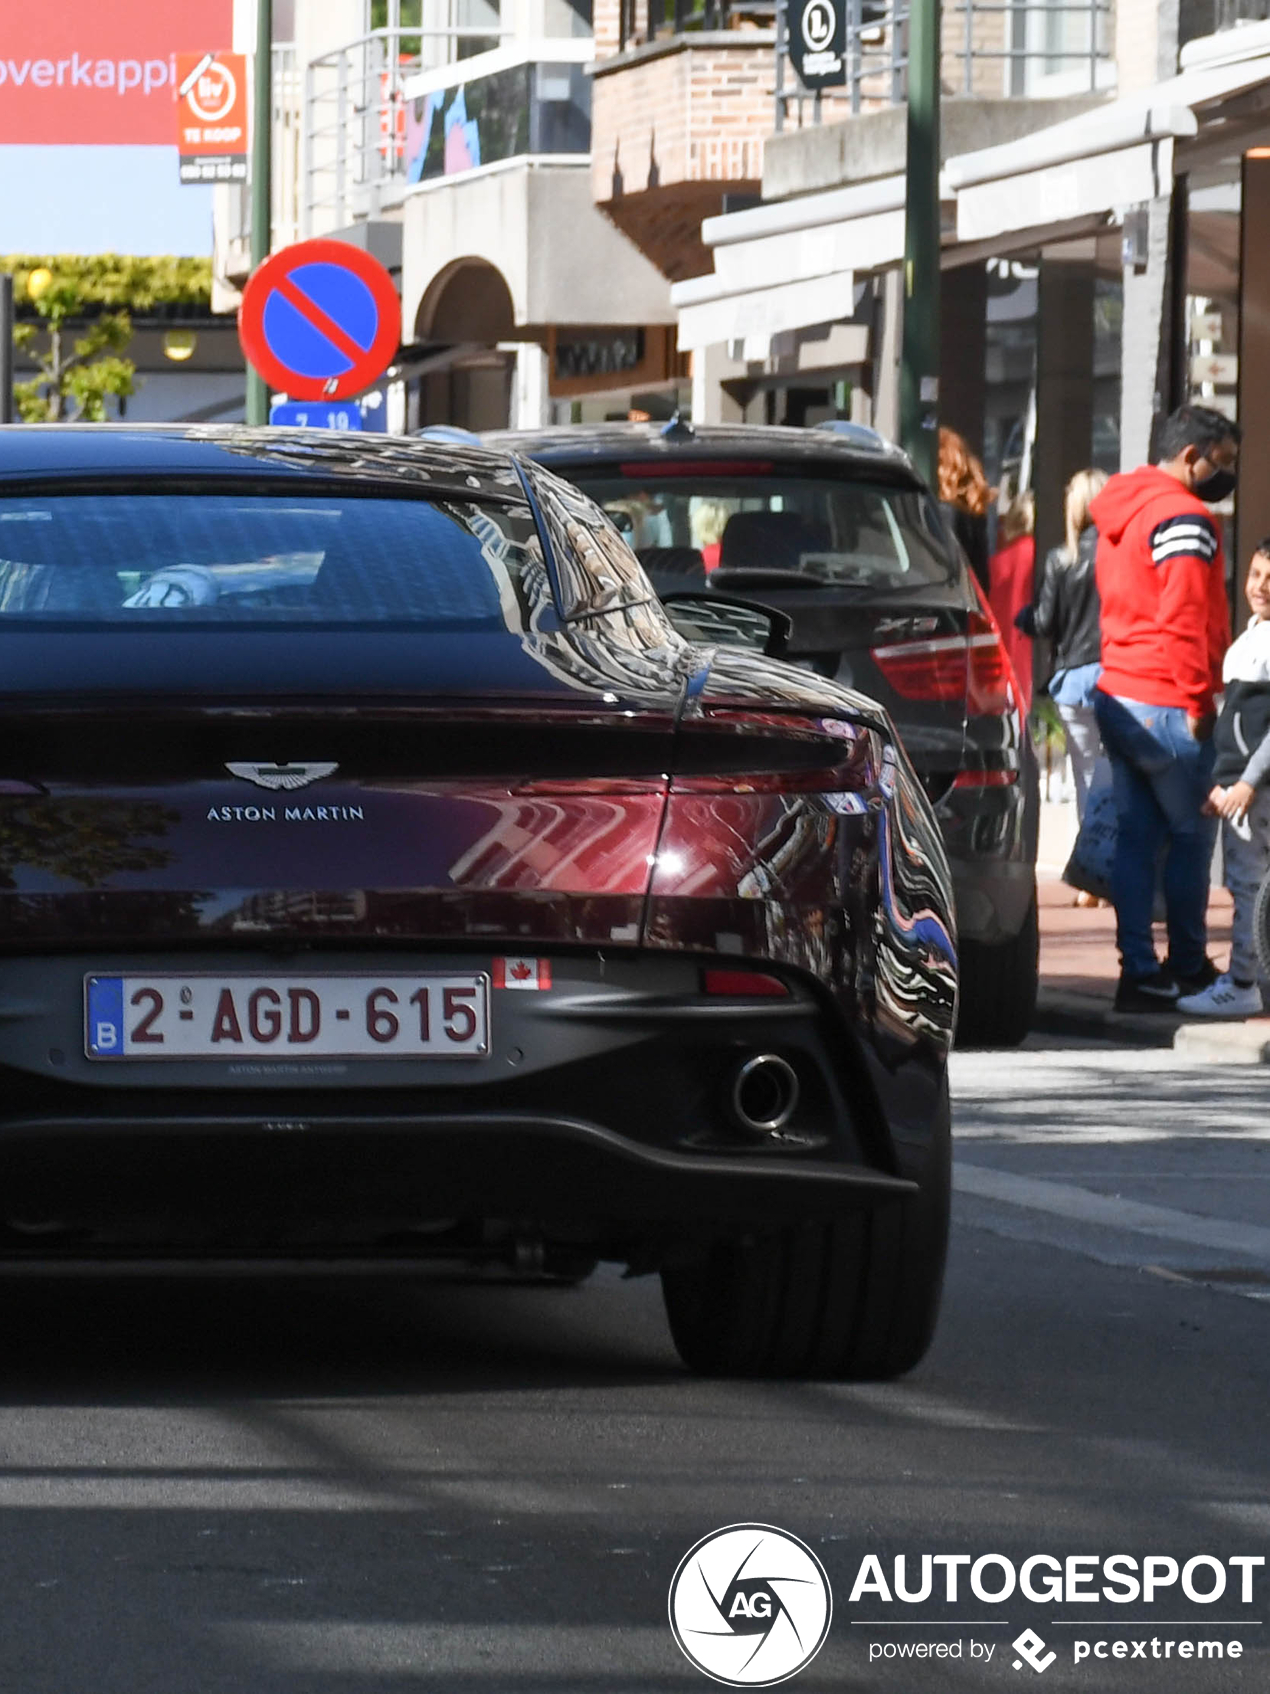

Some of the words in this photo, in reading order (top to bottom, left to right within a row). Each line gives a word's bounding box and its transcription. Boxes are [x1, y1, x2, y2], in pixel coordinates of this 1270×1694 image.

[206, 806, 276, 821] ASTON
[284, 806, 365, 821] MARTIN
[96, 1023, 118, 1049] B
